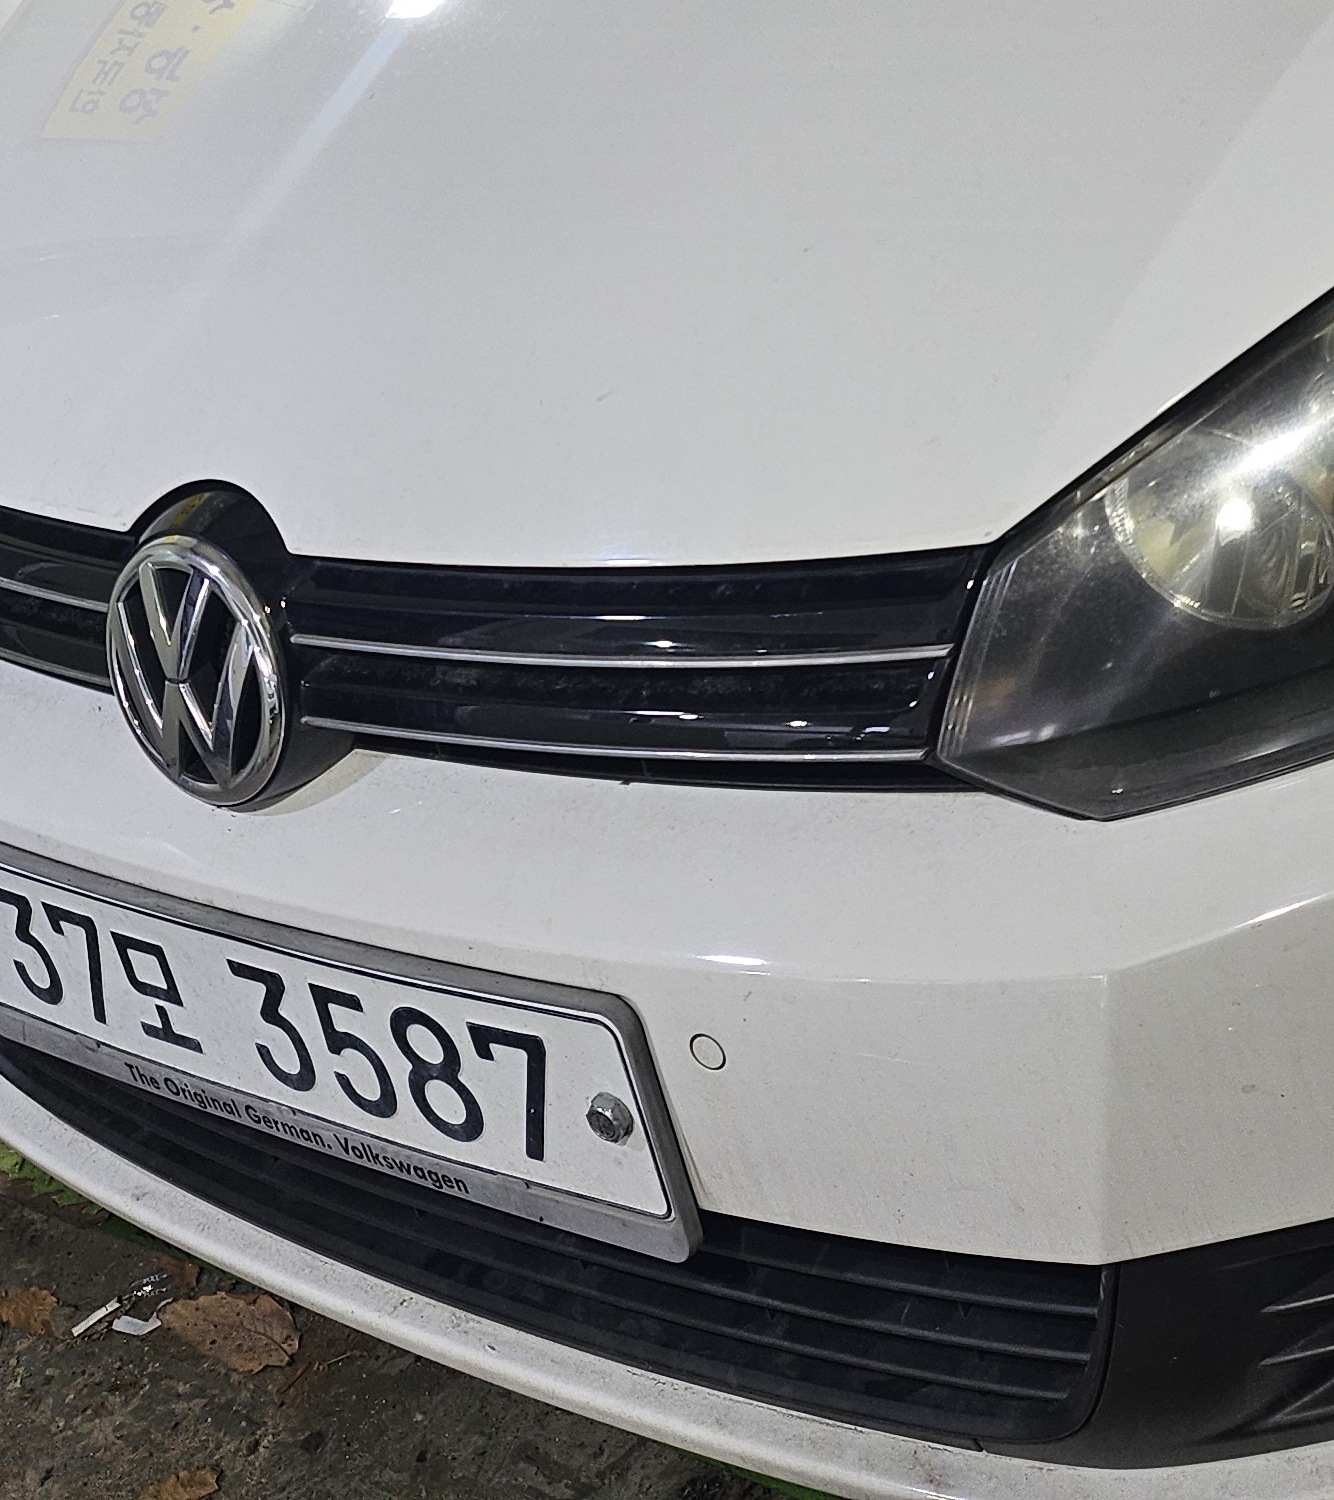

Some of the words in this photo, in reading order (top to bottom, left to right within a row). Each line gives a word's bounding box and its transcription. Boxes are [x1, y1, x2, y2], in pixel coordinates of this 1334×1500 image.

[124, 1062, 161, 1090] The
[163, 1077, 242, 1118] Original
[244, 1104, 333, 1150] German.
[333, 1133, 470, 1194] Volkswagen
[225, 958, 547, 1162] 3587
